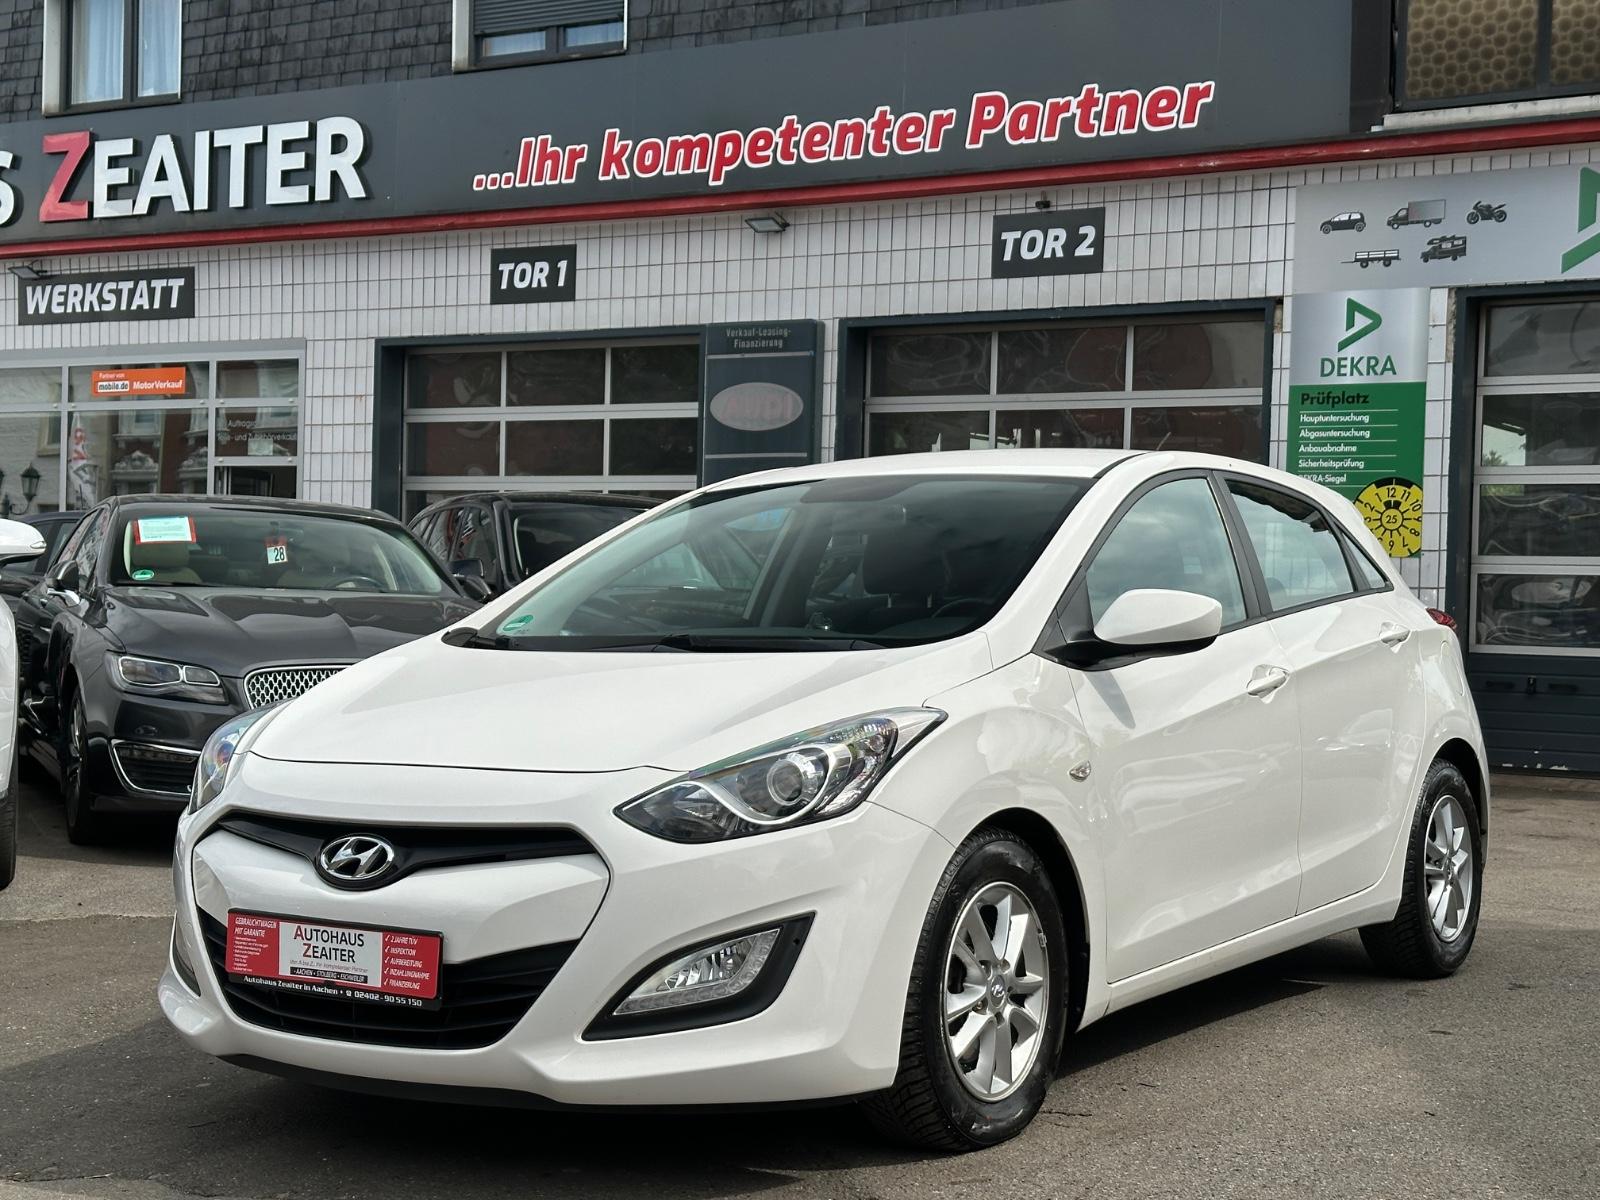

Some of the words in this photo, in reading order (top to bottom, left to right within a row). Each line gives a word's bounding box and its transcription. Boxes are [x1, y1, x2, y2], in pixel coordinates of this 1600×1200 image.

[473, 135, 587, 190] ...Ihr
[599, 105, 956, 186] kompetenter
[965, 81, 1214, 149] Partner
[39, 115, 366, 222] ZEAITER
[1001, 227, 1067, 261] TOR
[1074, 225, 1096, 256] 2
[498, 260, 548, 289] TOR
[557, 260, 567, 287] 1
[26, 277, 185, 315] WERKSTATT
[734, 338, 783, 349] Finanzierung
[1320, 354, 1397, 377] DEKRA
[98, 381, 129, 391] mobile.de
[132, 380, 183, 390] MotorVerkauf
[1301, 391, 1370, 408] Prüfplatz
[1300, 412, 1370, 424] Hauptuntersuchung
[1299, 428, 1371, 439] Abgasuntersuchung
[1299, 443, 1358, 453] Anbauabnahme
[1298, 458, 1365, 470] Sicherheitsprüfung
[1386, 487, 1397, 499] 12
[1401, 489, 1411, 502] 11
[1410, 499, 1422, 512] 10
[1386, 515, 1397, 524] 25
[274, 546, 285, 561] 28
[293, 924, 365, 947] AUTOHAUS
[302, 943, 356, 963] ZEAITER
[243, 975, 277, 987] Autohaus
[277, 981, 303, 990] Zeaiter
[303, 982, 310, 991] in
[311, 983, 338, 995] Aachen
